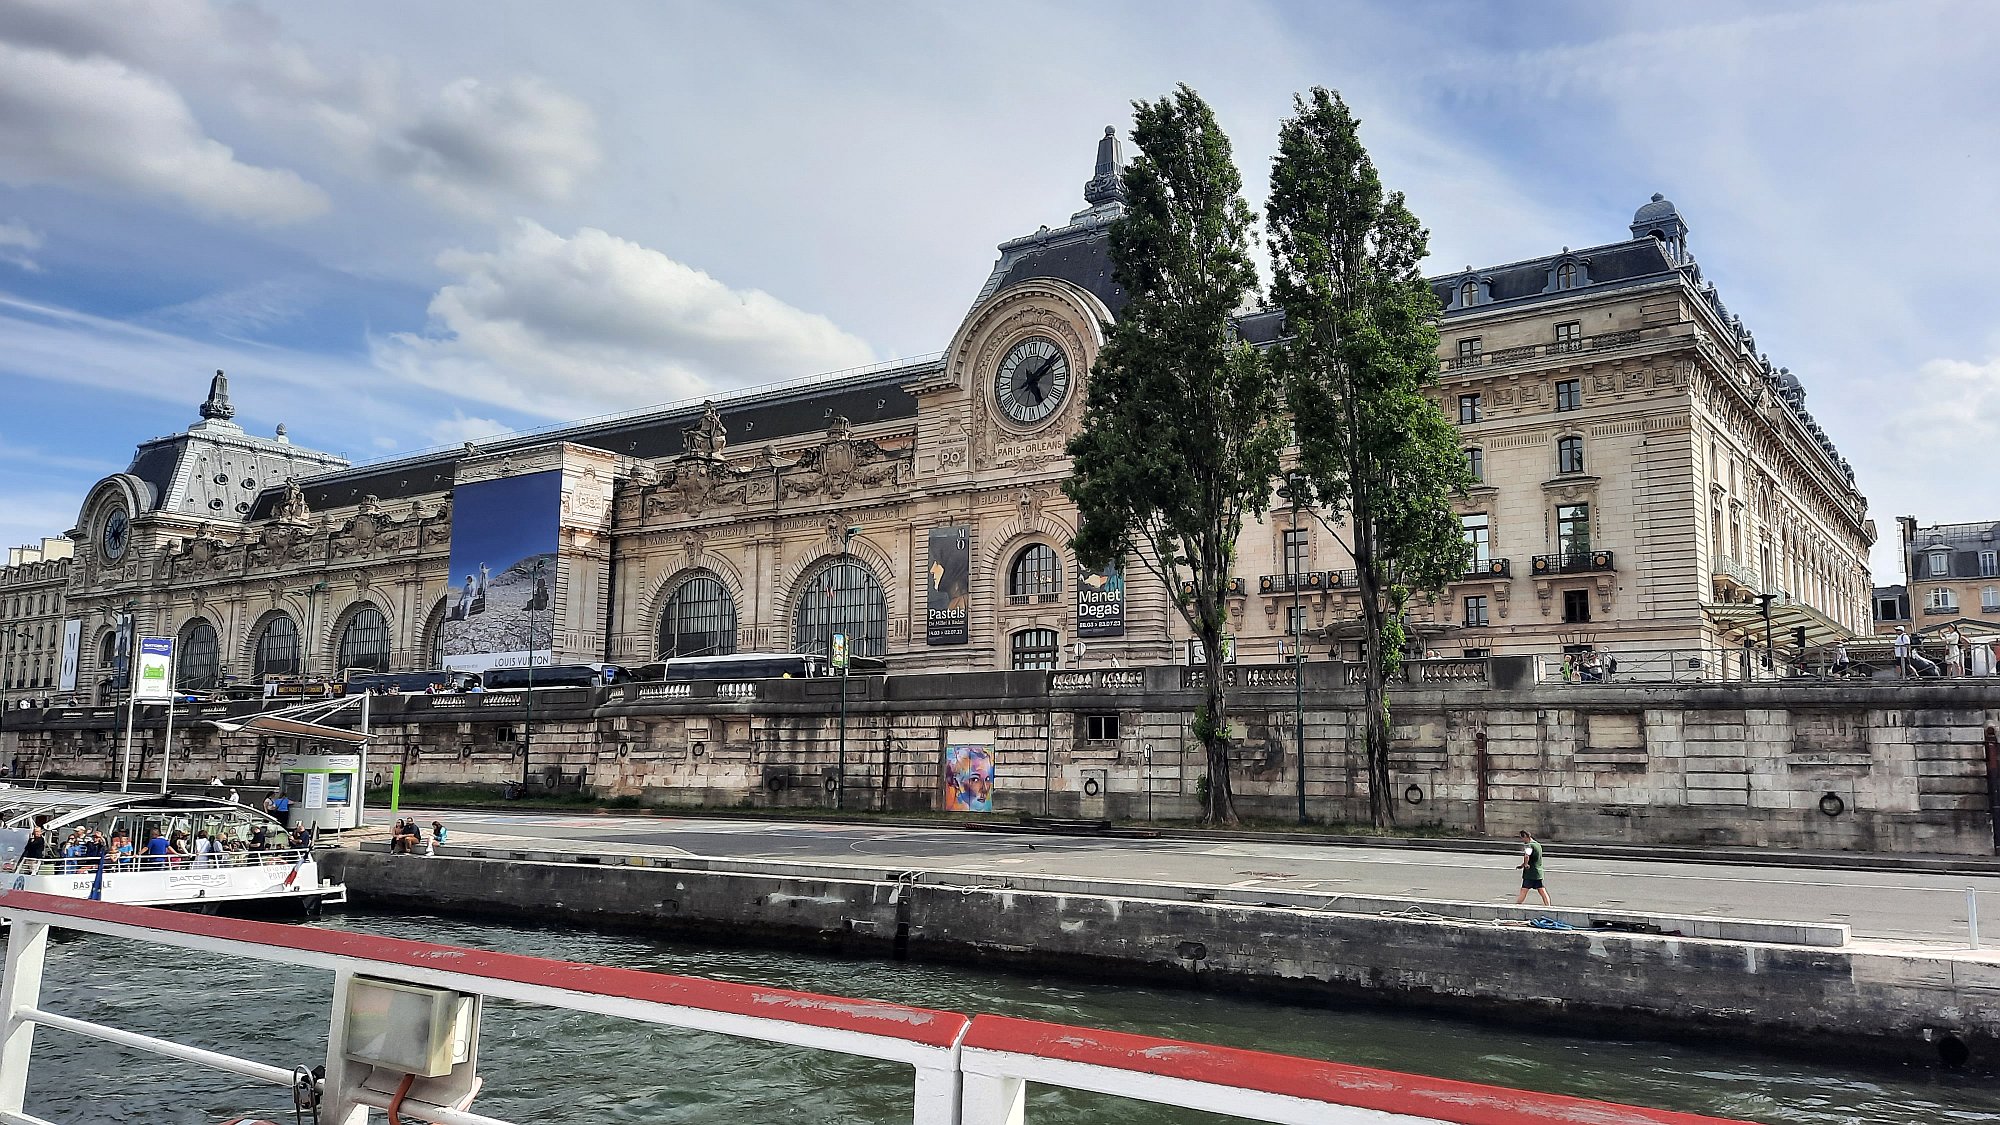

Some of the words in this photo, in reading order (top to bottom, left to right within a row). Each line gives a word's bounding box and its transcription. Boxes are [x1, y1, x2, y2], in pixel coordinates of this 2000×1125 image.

[941, 452, 960, 465] PO
[1079, 589, 1121, 603] Manet
[929, 606, 966, 620] Pastels
[1079, 603, 1120, 619] Degas
[494, 657, 516, 667] LOUIS
[517, 655, 549, 666] VUITON
[169, 874, 226, 883] BATOBUS
